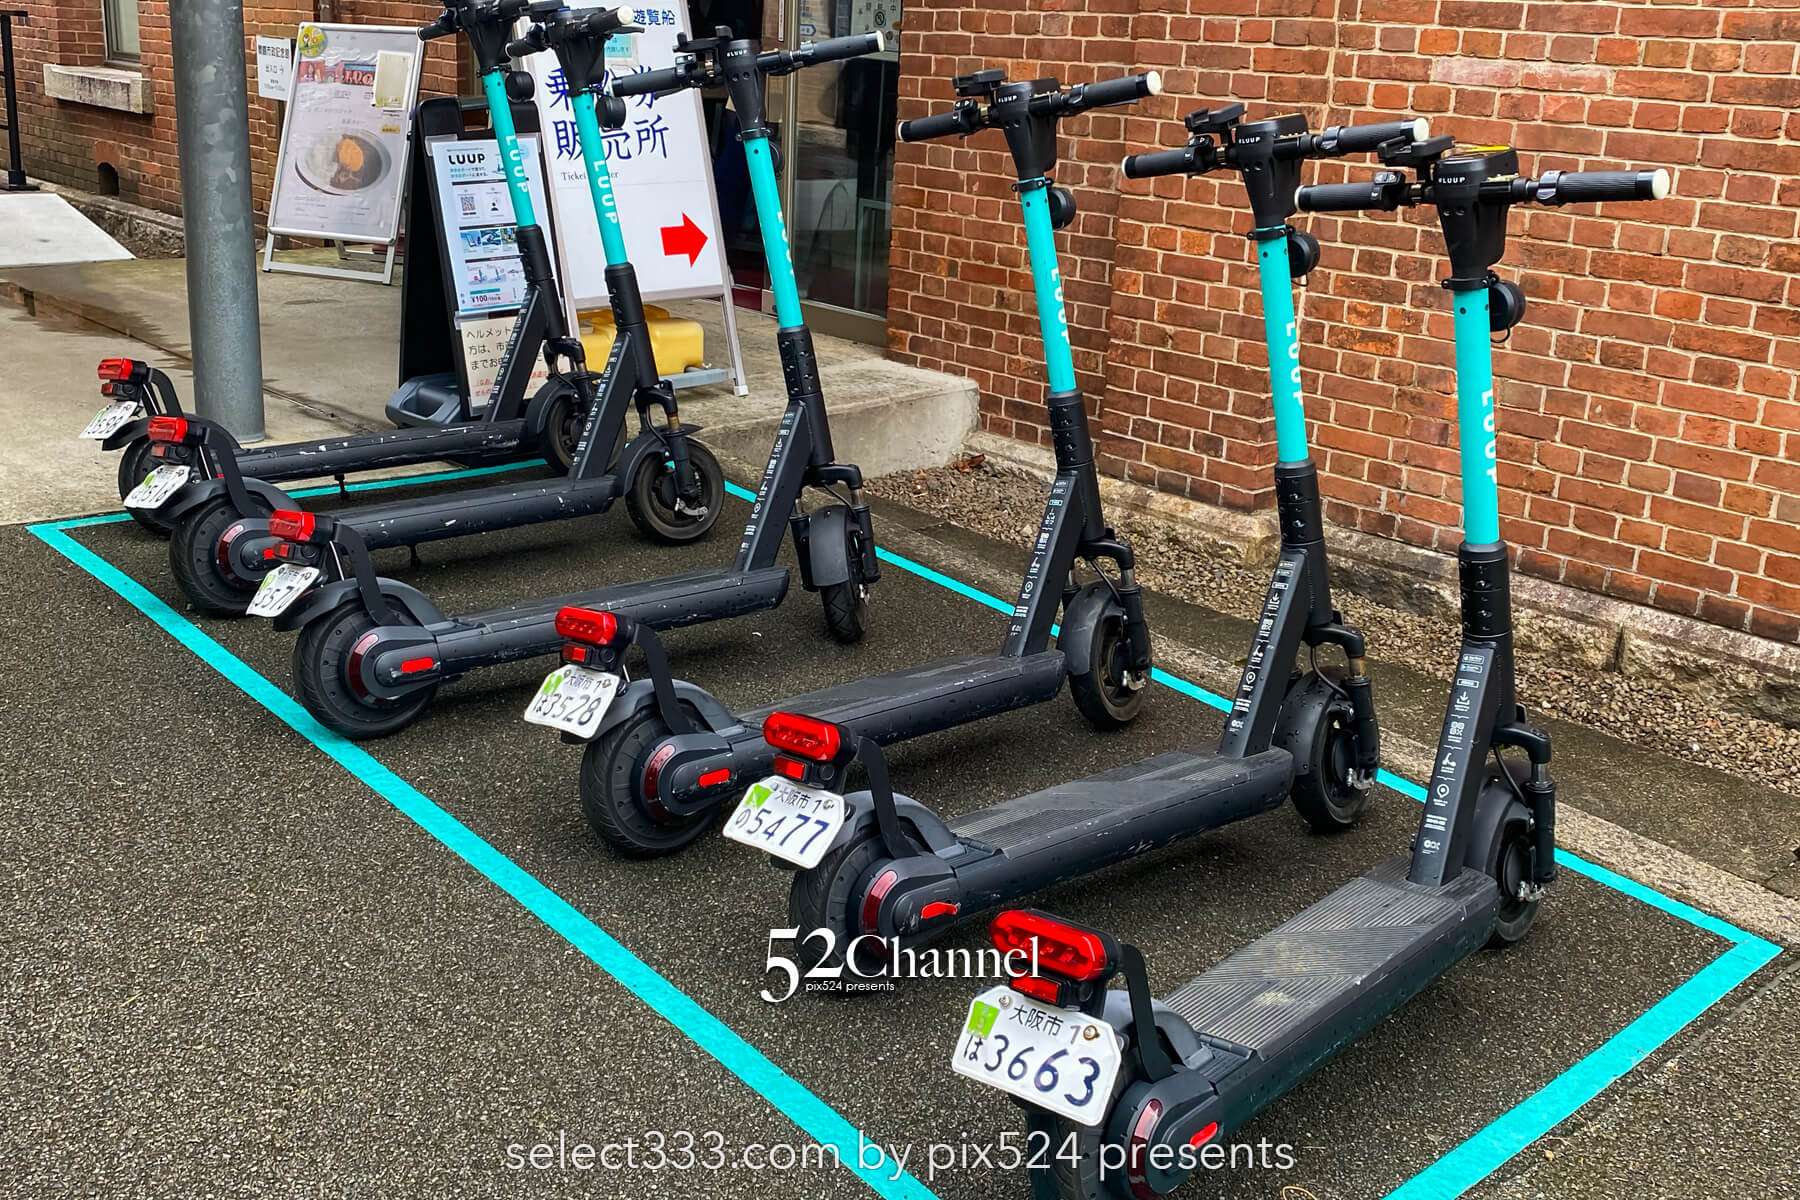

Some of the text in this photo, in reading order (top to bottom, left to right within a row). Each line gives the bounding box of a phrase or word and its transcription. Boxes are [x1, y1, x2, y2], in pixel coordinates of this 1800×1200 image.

[448, 153, 485, 166] LUUP
[505, 135, 529, 193] LUUP
[1442, 176, 1466, 184] LUUP
[593, 160, 619, 224] LUUP
[466, 326, 511, 338] ヘルメット
[775, 789, 812, 809] 大阪市
[1009, 1004, 1064, 1037] 大阪市
